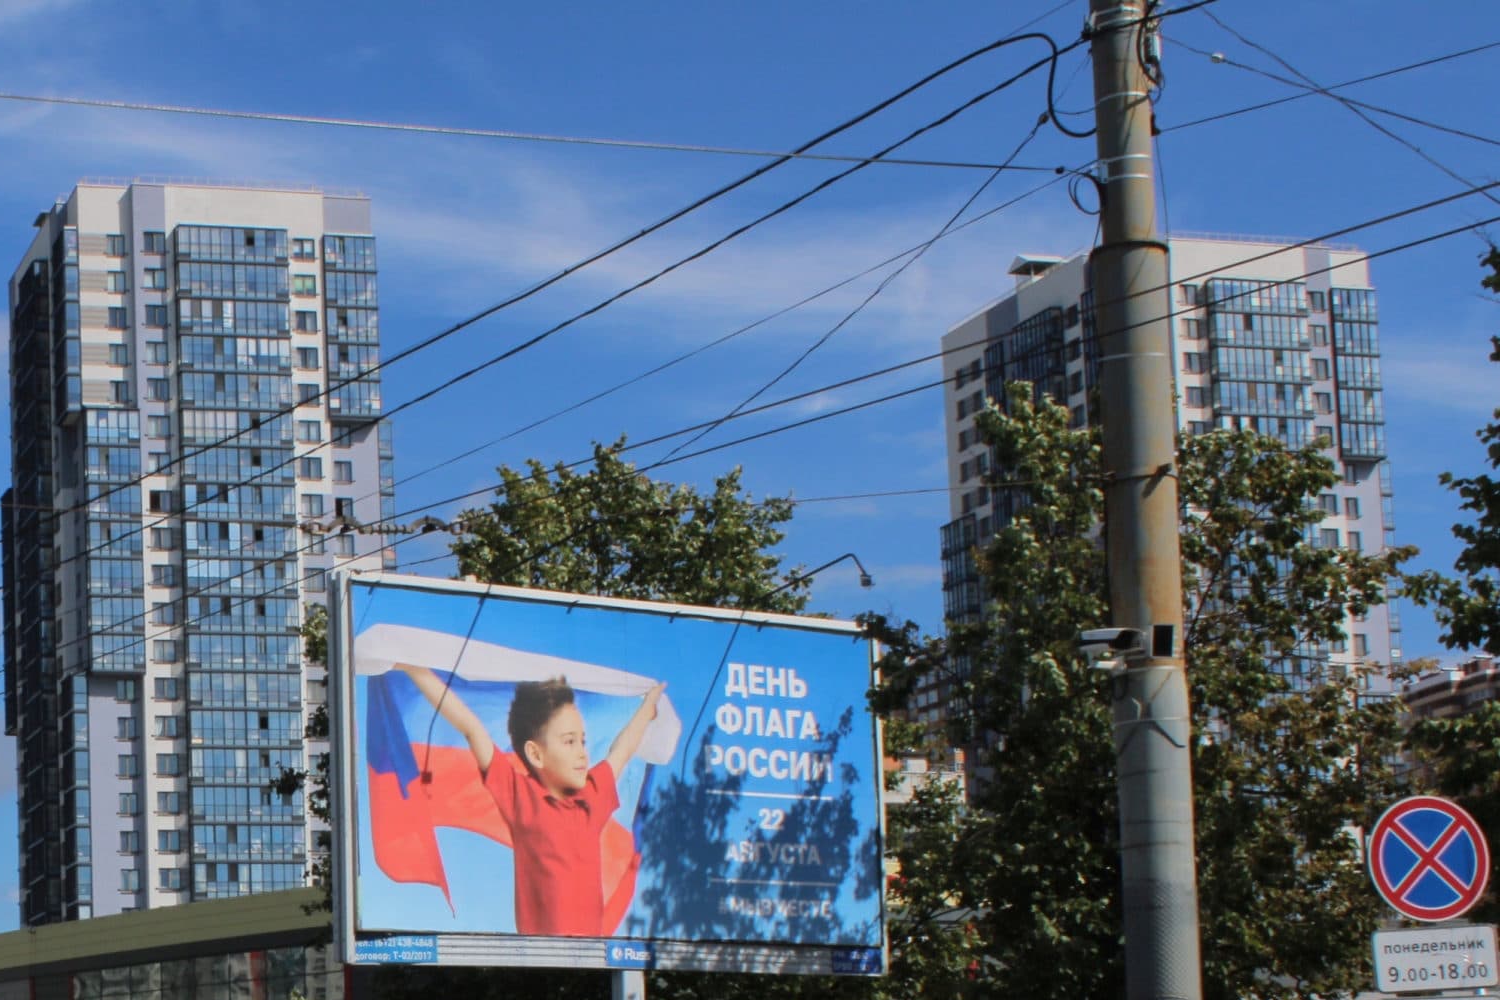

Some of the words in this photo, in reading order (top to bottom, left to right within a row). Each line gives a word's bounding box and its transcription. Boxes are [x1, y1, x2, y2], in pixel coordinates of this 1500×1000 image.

[725, 663, 808, 699] ДЕНЬ
[715, 703, 820, 741] ФЛАГА
[705, 744, 833, 783] РОССИИ
[758, 807, 785, 830] 22
[724, 840, 822, 865] АВГУСТА
[624, 947, 651, 961] Russ
[1383, 939, 1485, 954] понедельник
[1388, 963, 1488, 983] 9.00-18.00
